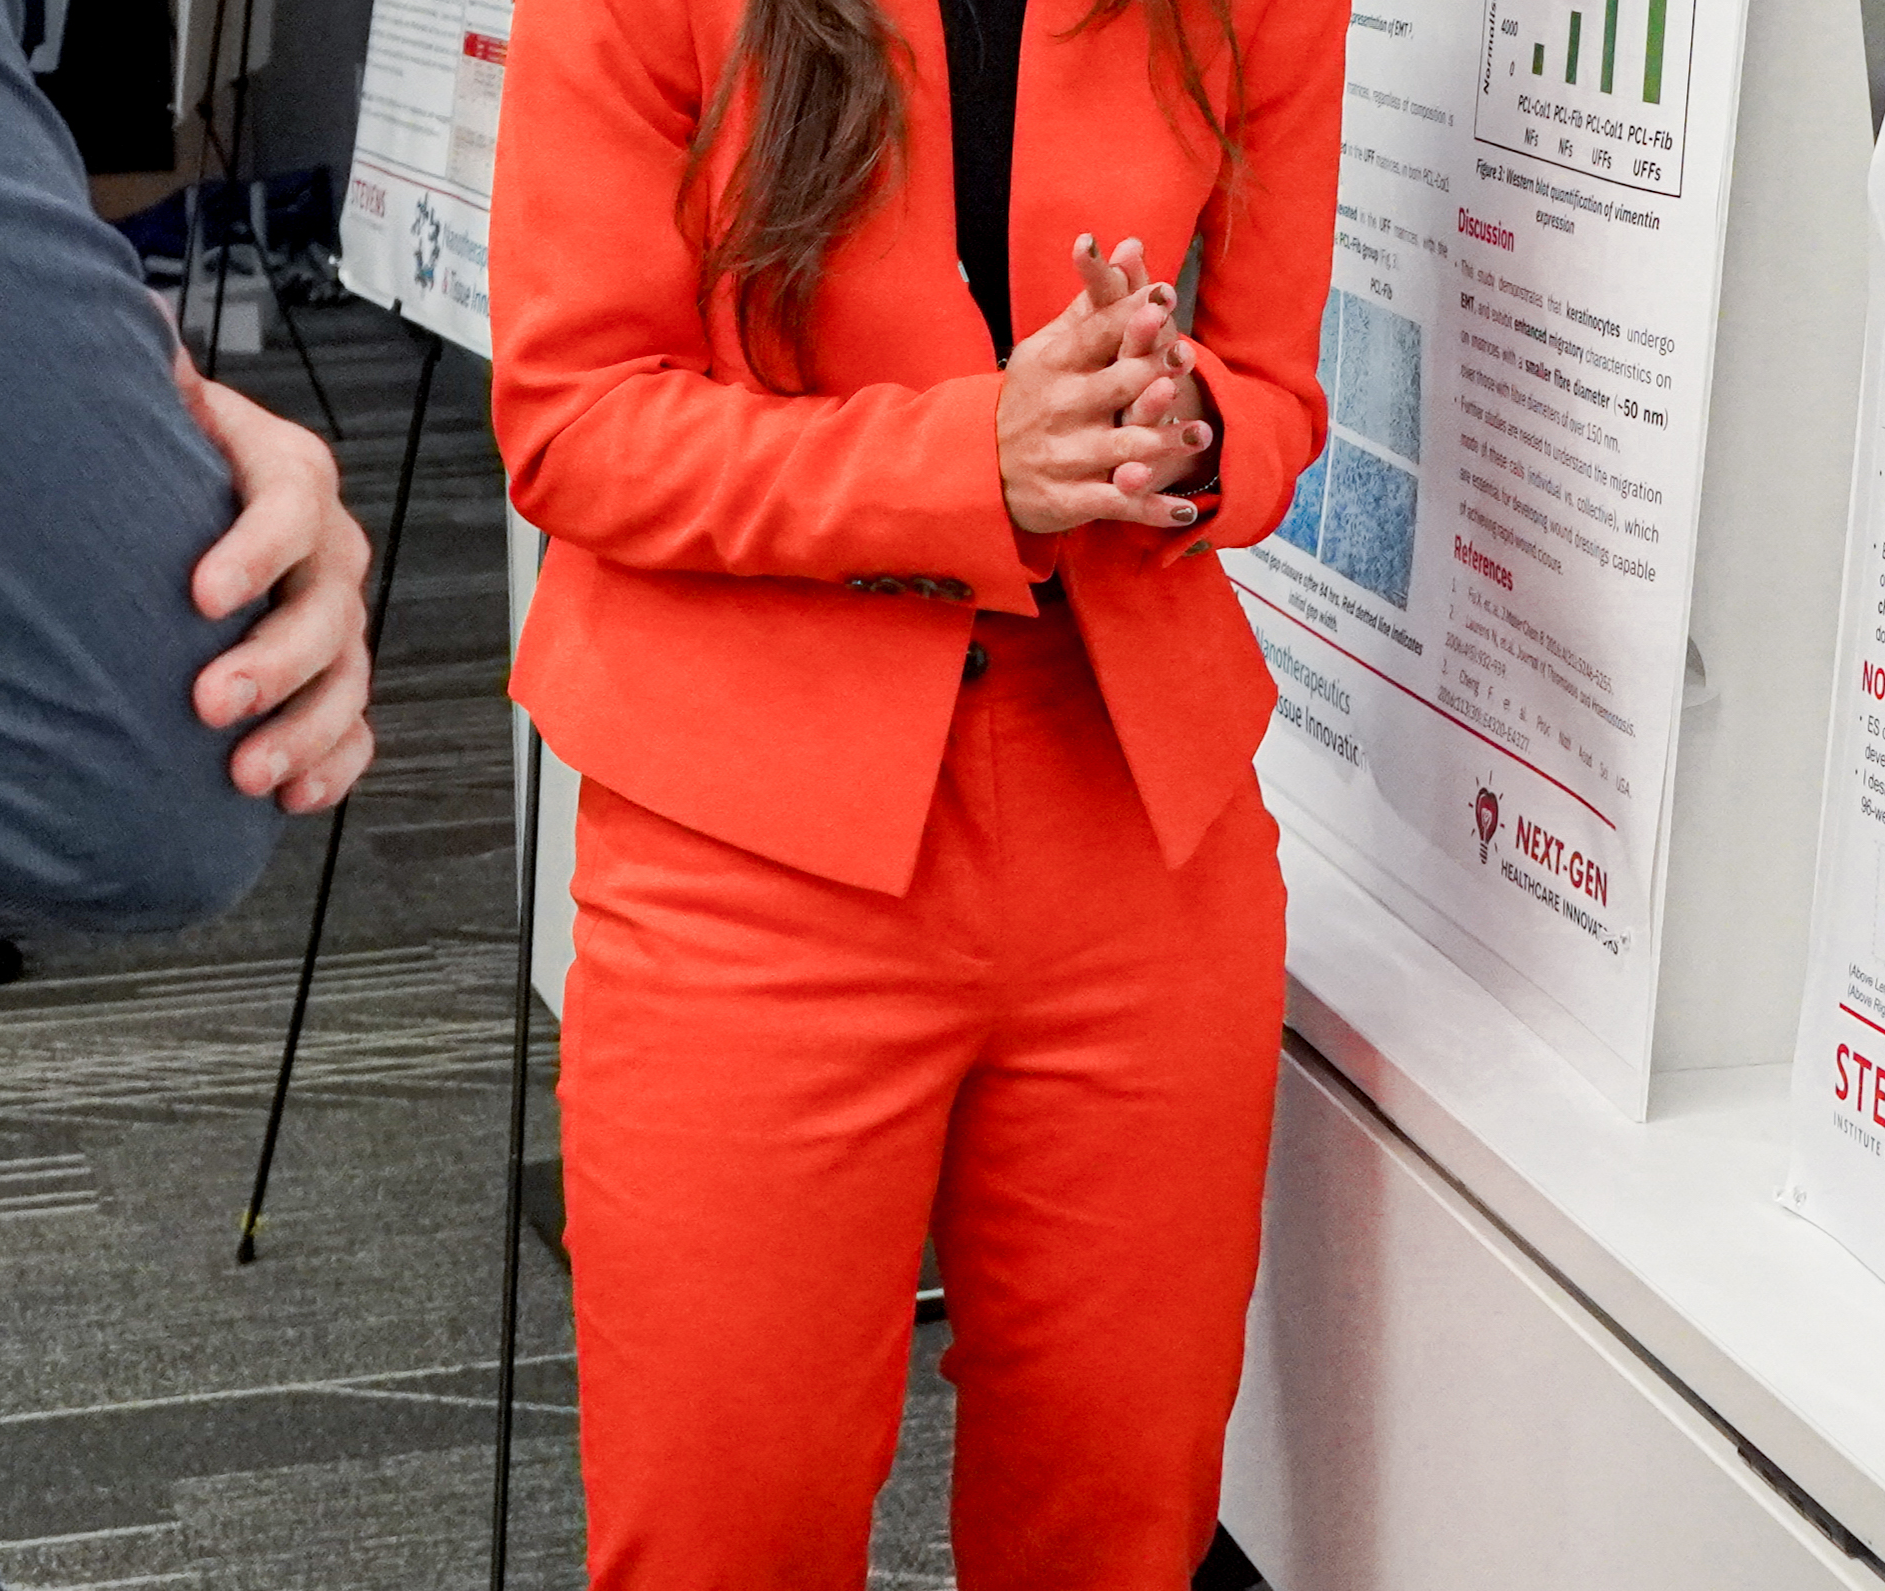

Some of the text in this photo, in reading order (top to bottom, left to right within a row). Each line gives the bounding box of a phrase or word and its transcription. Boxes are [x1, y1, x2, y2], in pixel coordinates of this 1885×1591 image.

[1627, 125, 1673, 151] PCL-Fib
[1591, 149, 1662, 182] UFFs UFFs
[1457, 206, 1515, 253] Discussion
[1536, 209, 1575, 234] expression
[1550, 185, 1602, 215] quantification
[1614, 203, 1660, 230] vimentin
[1566, 301, 1675, 357] keratinocytes undergo
[1615, 398, 1669, 430] (~50 nm)
[1451, 534, 1514, 593] References
[1275, 693, 1303, 731] issue
[1515, 815, 1608, 909] NEXT-GEN
[1501, 859, 1560, 914] HEALTHCARE
[1833, 1111, 1881, 1157] INSTITUTE
